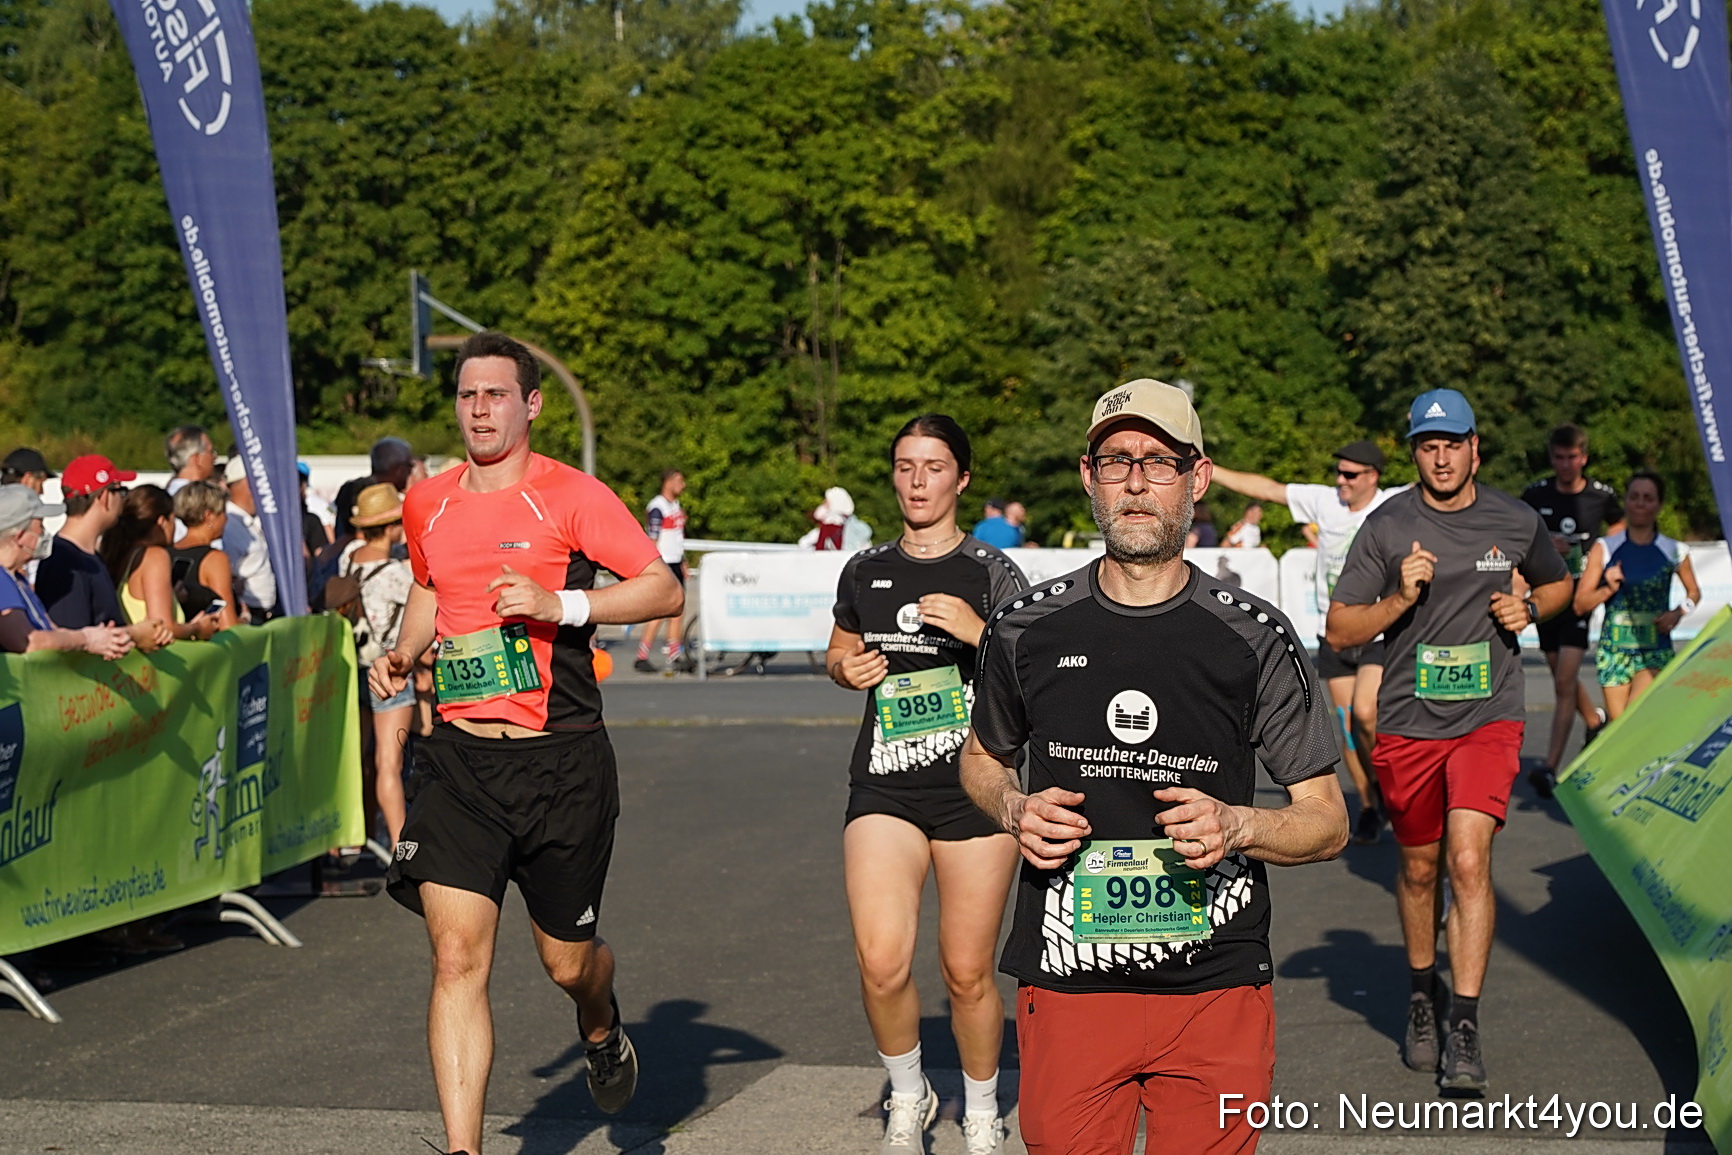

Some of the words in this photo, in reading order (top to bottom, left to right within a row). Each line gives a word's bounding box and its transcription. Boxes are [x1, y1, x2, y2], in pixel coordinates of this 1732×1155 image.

[1106, 392, 1132, 409] ROCK
[870, 579, 893, 588] JAKO
[446, 656, 486, 682] 133
[493, 654, 510, 687] 2022
[1057, 655, 1088, 668] JAKO
[465, 678, 496, 690] Michael
[1434, 664, 1474, 682] 754
[897, 692, 943, 718] 989
[950, 690, 965, 720] 2022
[882, 706, 894, 730] RUN
[1048, 741, 1219, 773] Bärnreuther+Deuerlein
[1079, 764, 1182, 784] SCHOTTERWERKE
[395, 840, 419, 862] 57
[1106, 857, 1149, 868] Firmenlauf
[1106, 875, 1176, 909] 998
[1081, 887, 1092, 923] RUN
[1092, 912, 1132, 926] Hepler
[1136, 910, 1191, 924] Christian
